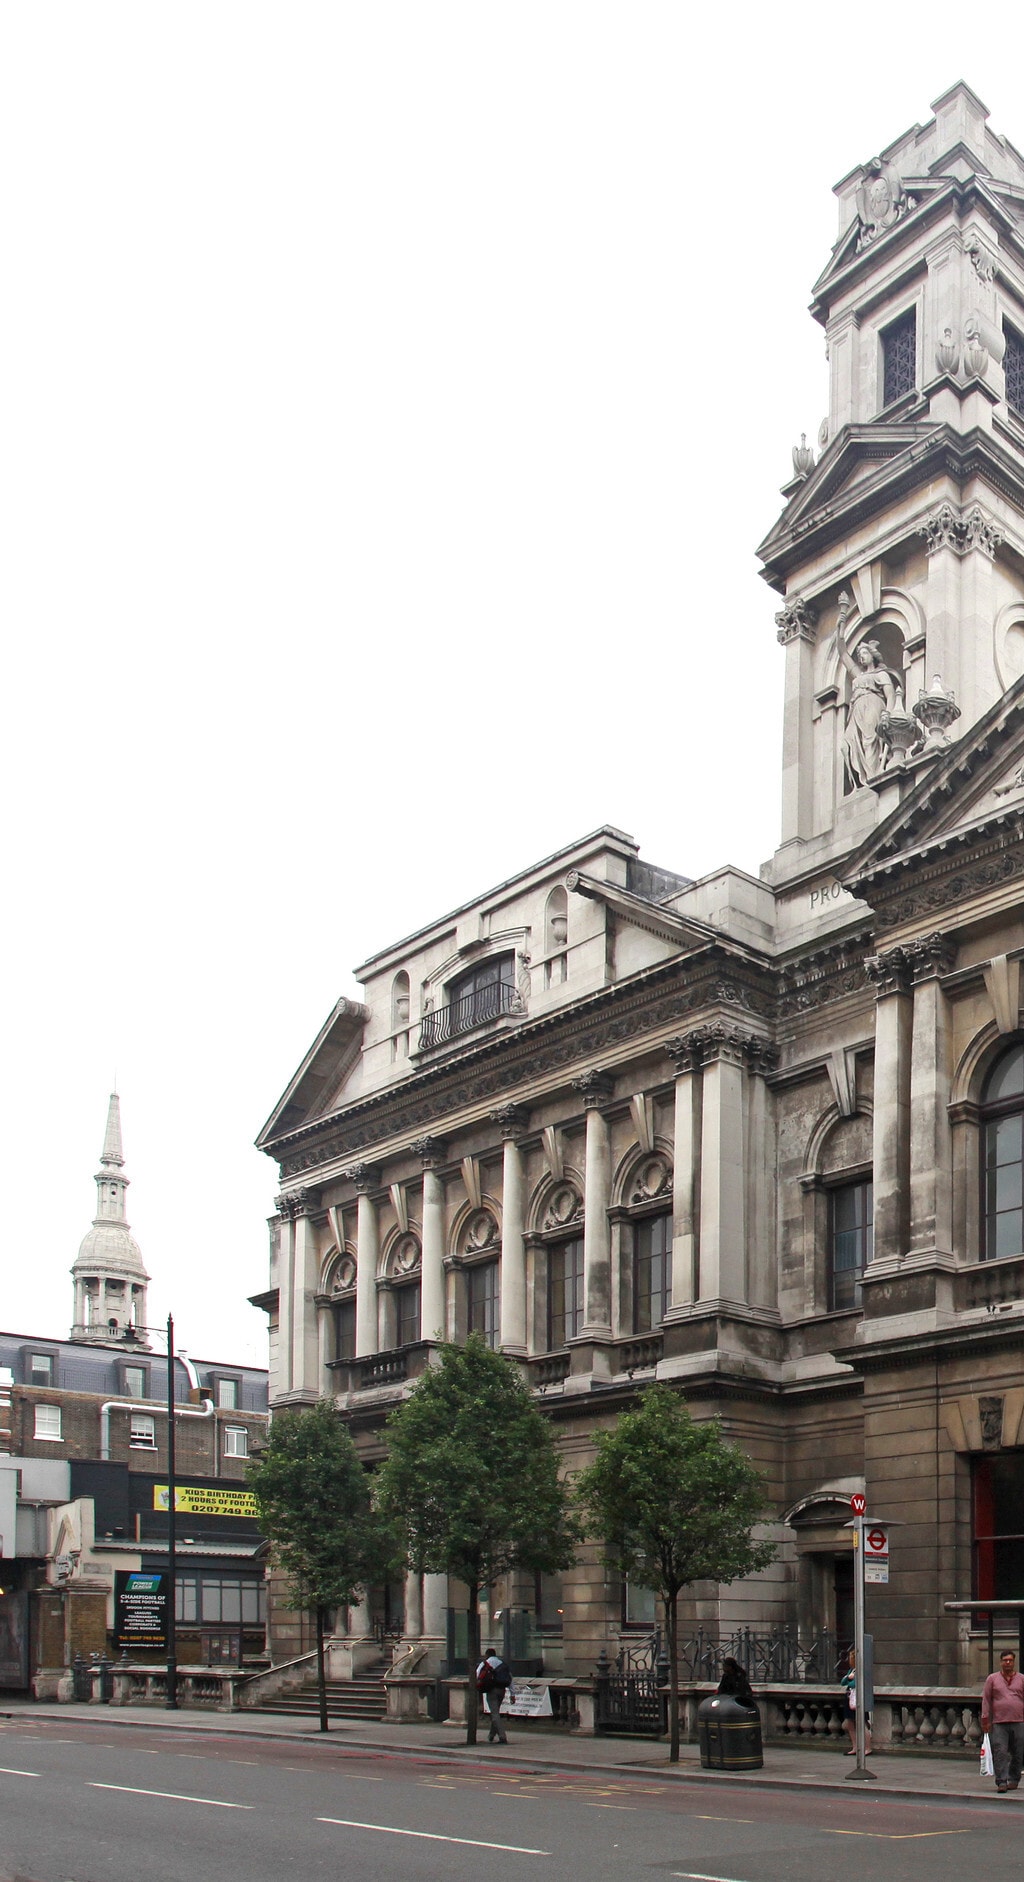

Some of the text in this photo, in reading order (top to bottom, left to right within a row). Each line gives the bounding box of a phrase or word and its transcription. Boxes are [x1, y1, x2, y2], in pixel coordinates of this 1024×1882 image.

[184, 1488, 205, 1496] KIDS
[206, 1490, 247, 1500] BIRTHDAY
[188, 1496, 217, 1504] HOURS
[853, 1499, 865, 1510] W
[191, 1504, 220, 1513] 0207
[221, 1506, 242, 1515] 749
